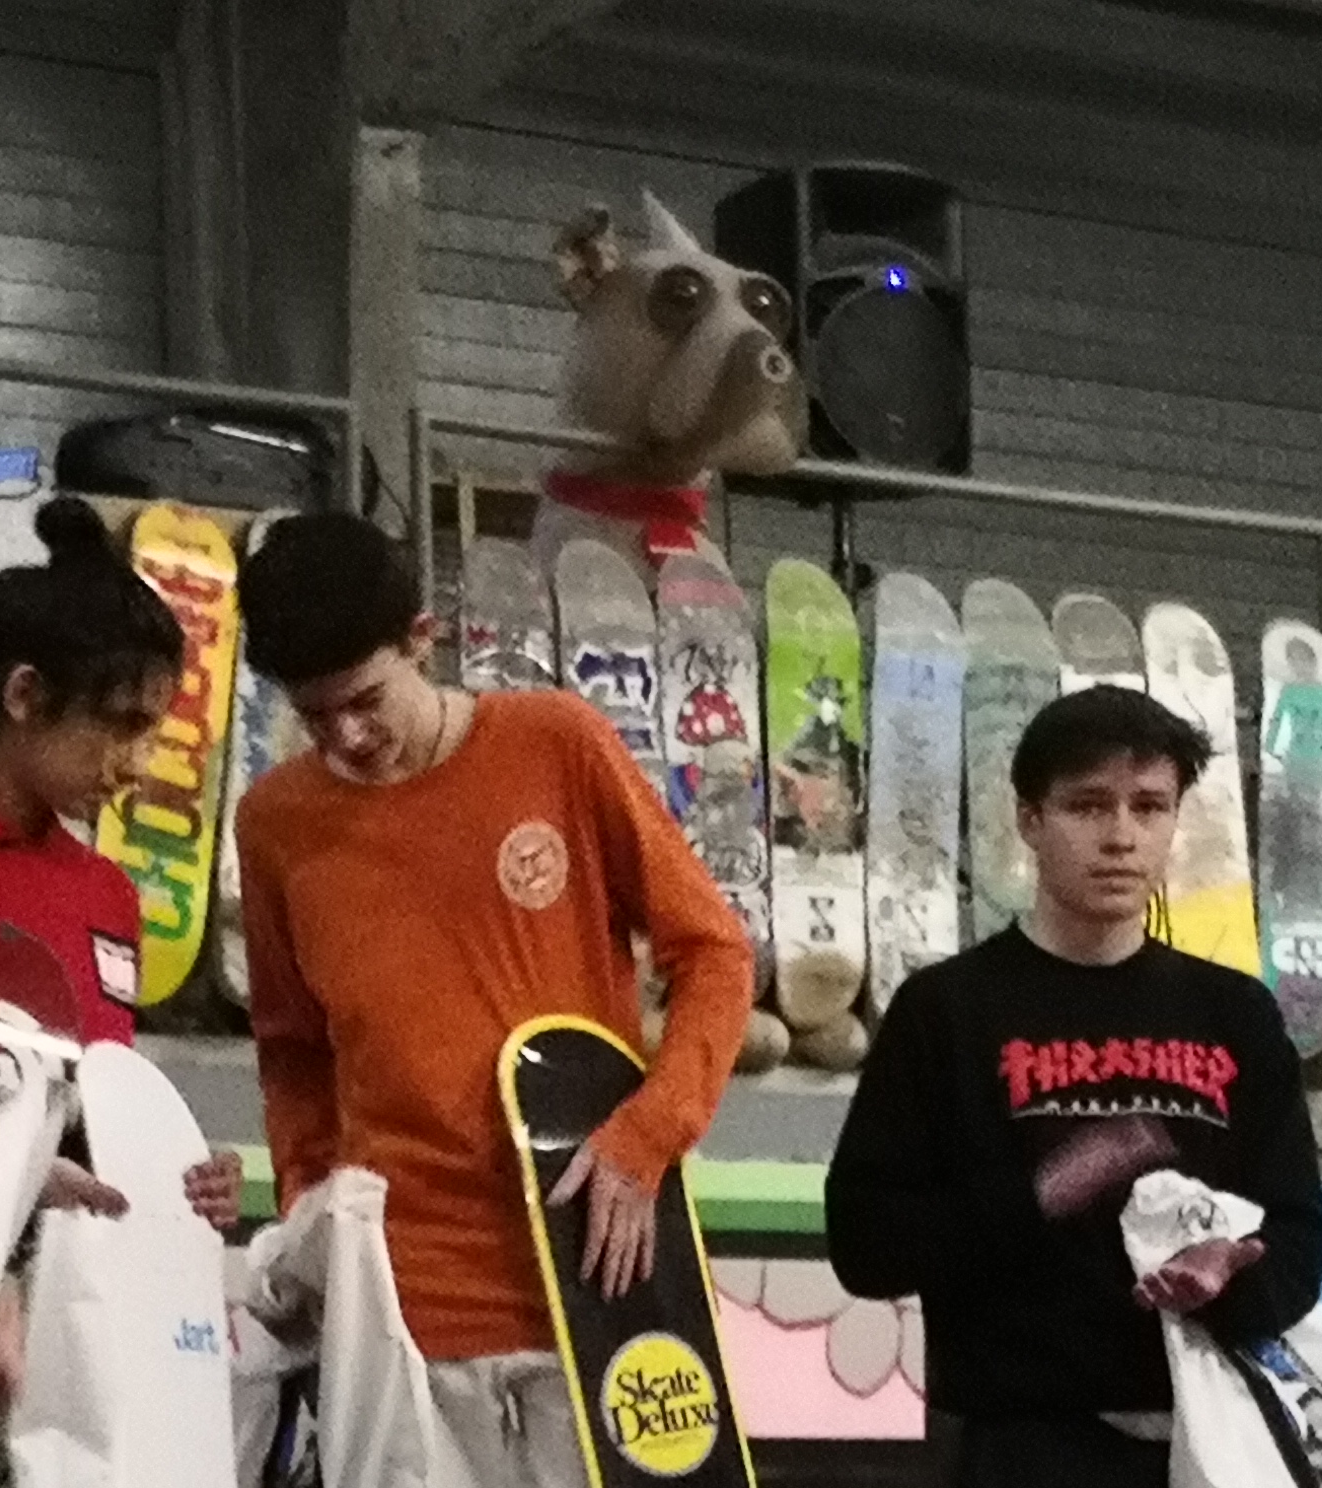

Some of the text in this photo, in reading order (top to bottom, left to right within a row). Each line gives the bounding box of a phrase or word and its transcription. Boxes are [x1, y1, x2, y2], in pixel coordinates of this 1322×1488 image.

[997, 1036, 1238, 1117] THRASHER
[615, 1367, 701, 1405] Skate
[612, 1401, 719, 1445] Deluxe
